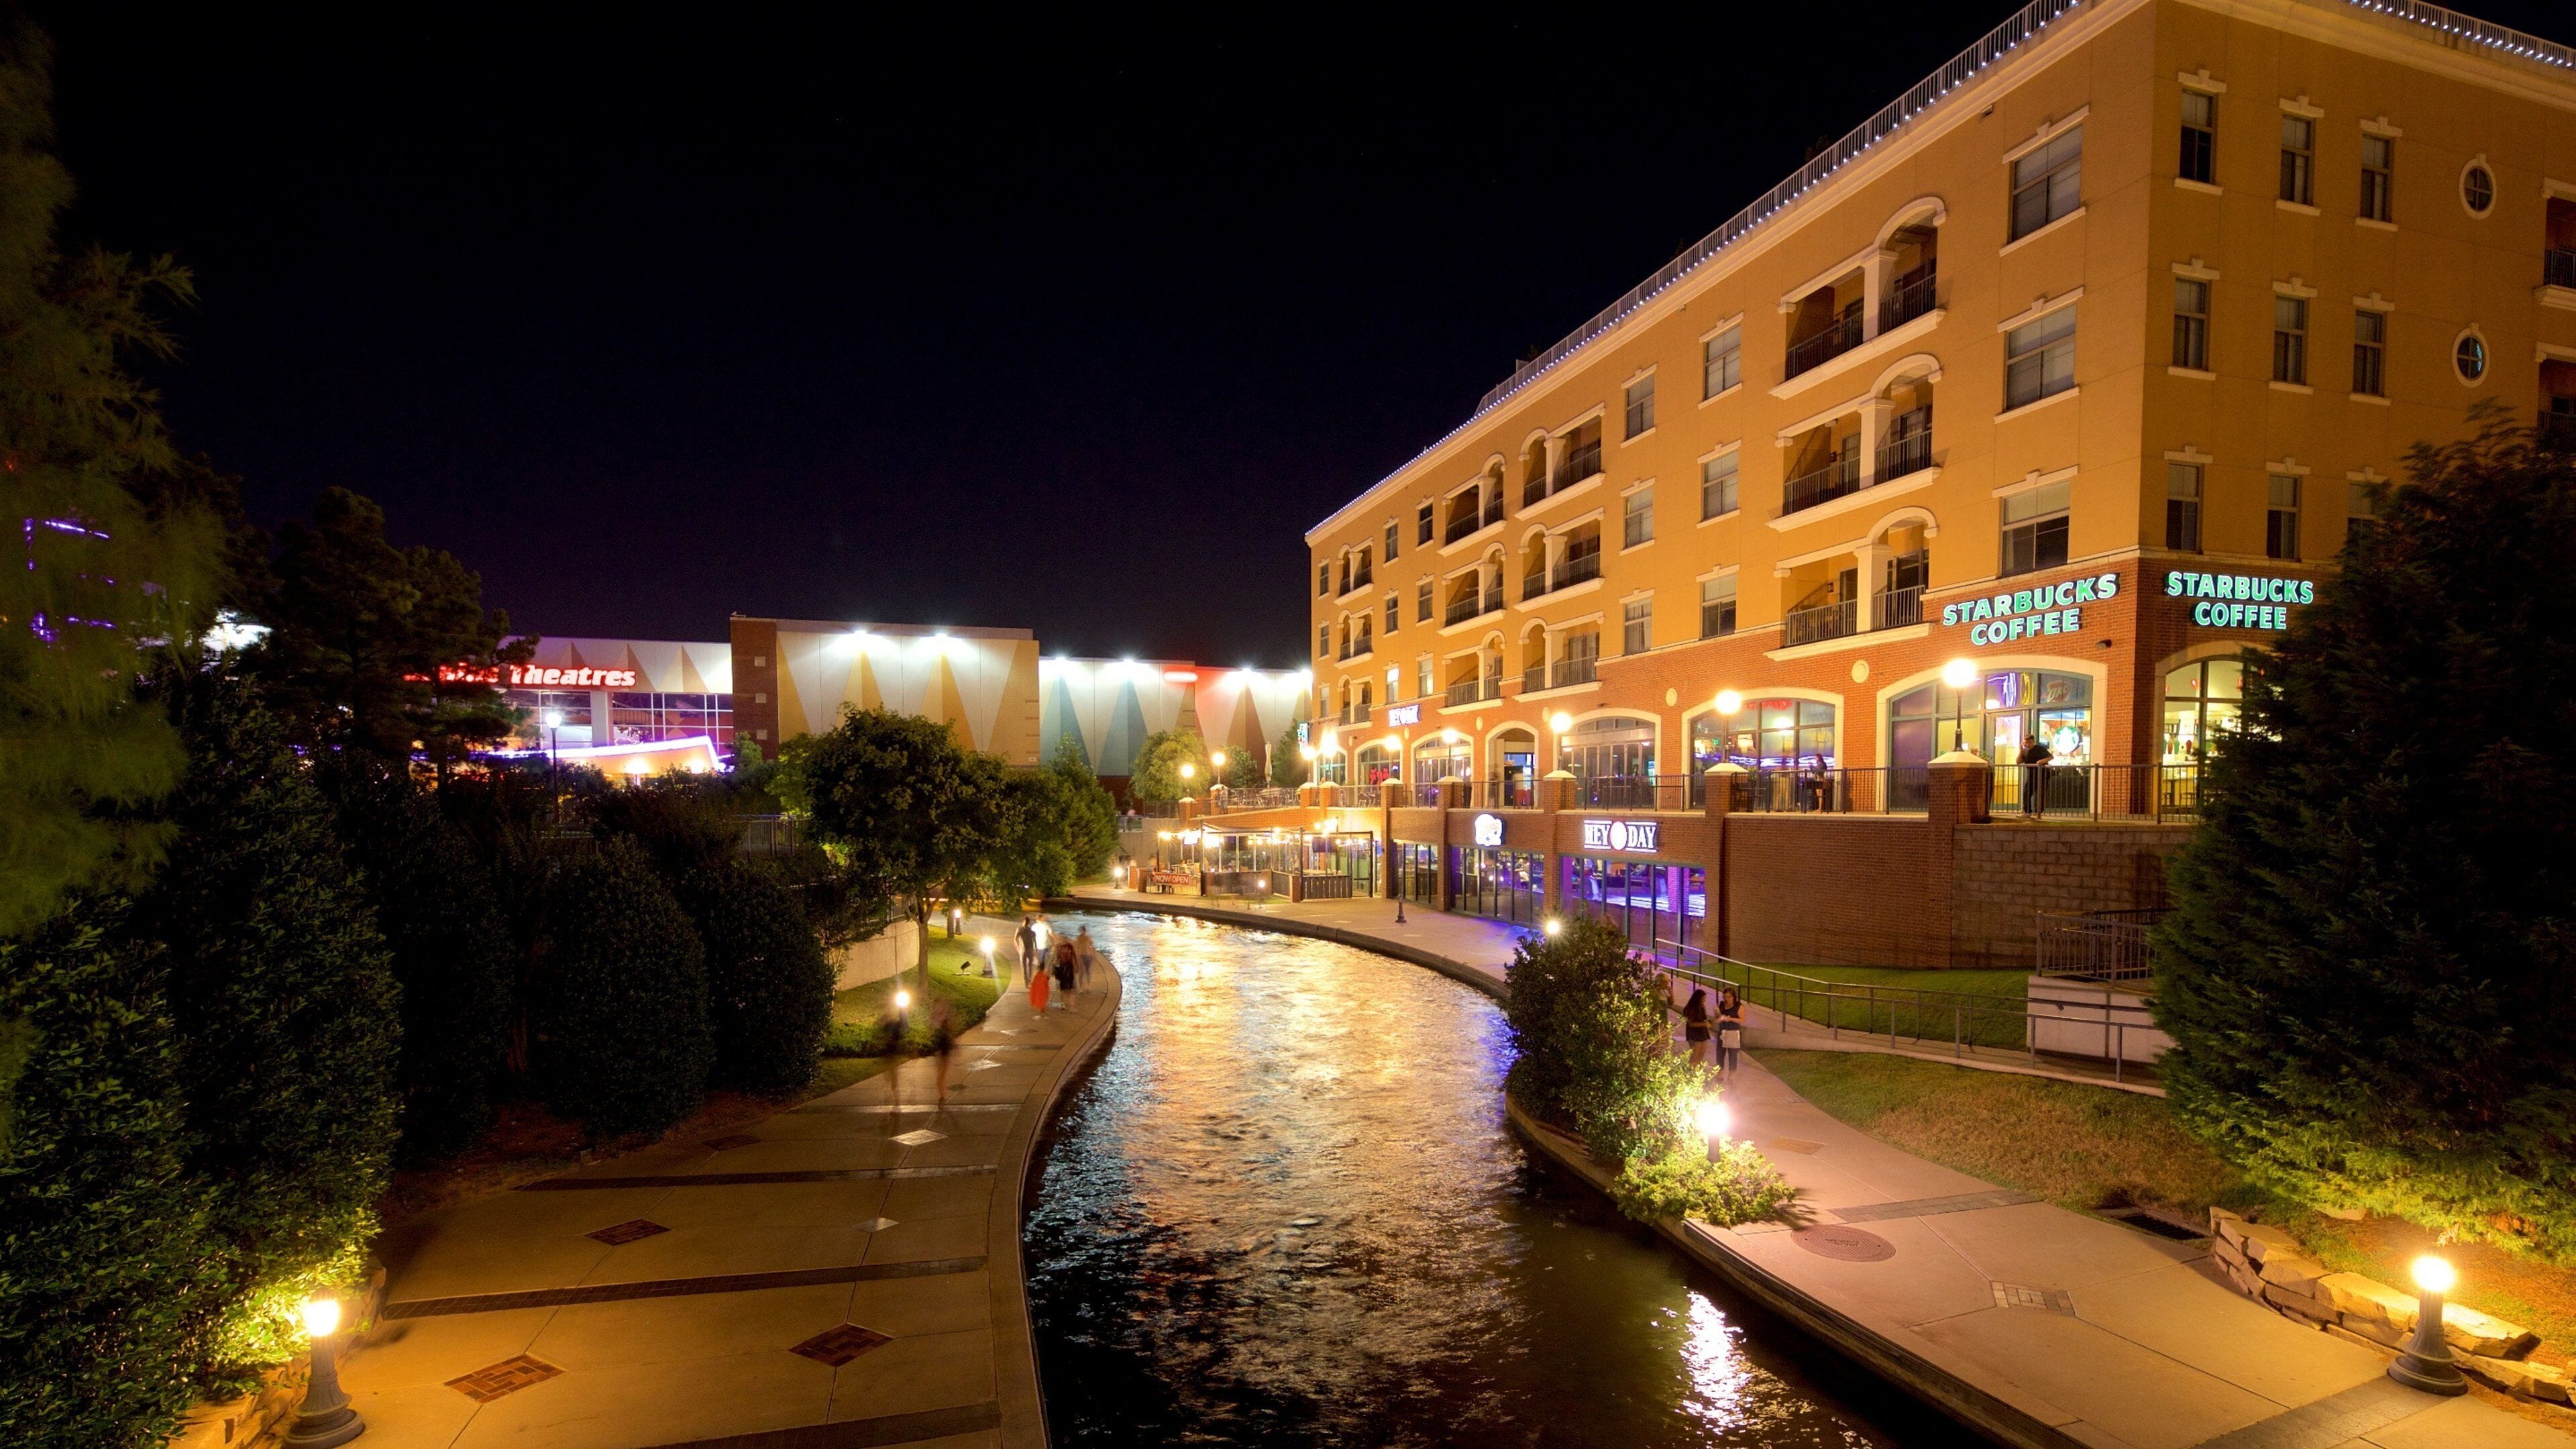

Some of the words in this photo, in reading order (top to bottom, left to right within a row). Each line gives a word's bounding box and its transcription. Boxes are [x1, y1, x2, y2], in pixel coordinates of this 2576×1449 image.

[1943, 574, 2116, 626] STARBUCKS
[2167, 571, 2314, 604] STARBUCKS
[1970, 608, 2080, 645] COFFEE
[2195, 602, 2287, 630] COFFEE
[509, 664, 636, 686] Theatres
[1584, 824, 1610, 845] HEY
[1627, 825, 1656, 849] DAY
[1155, 875, 1171, 883] NOW
[1171, 875, 1189, 883] OPEN
